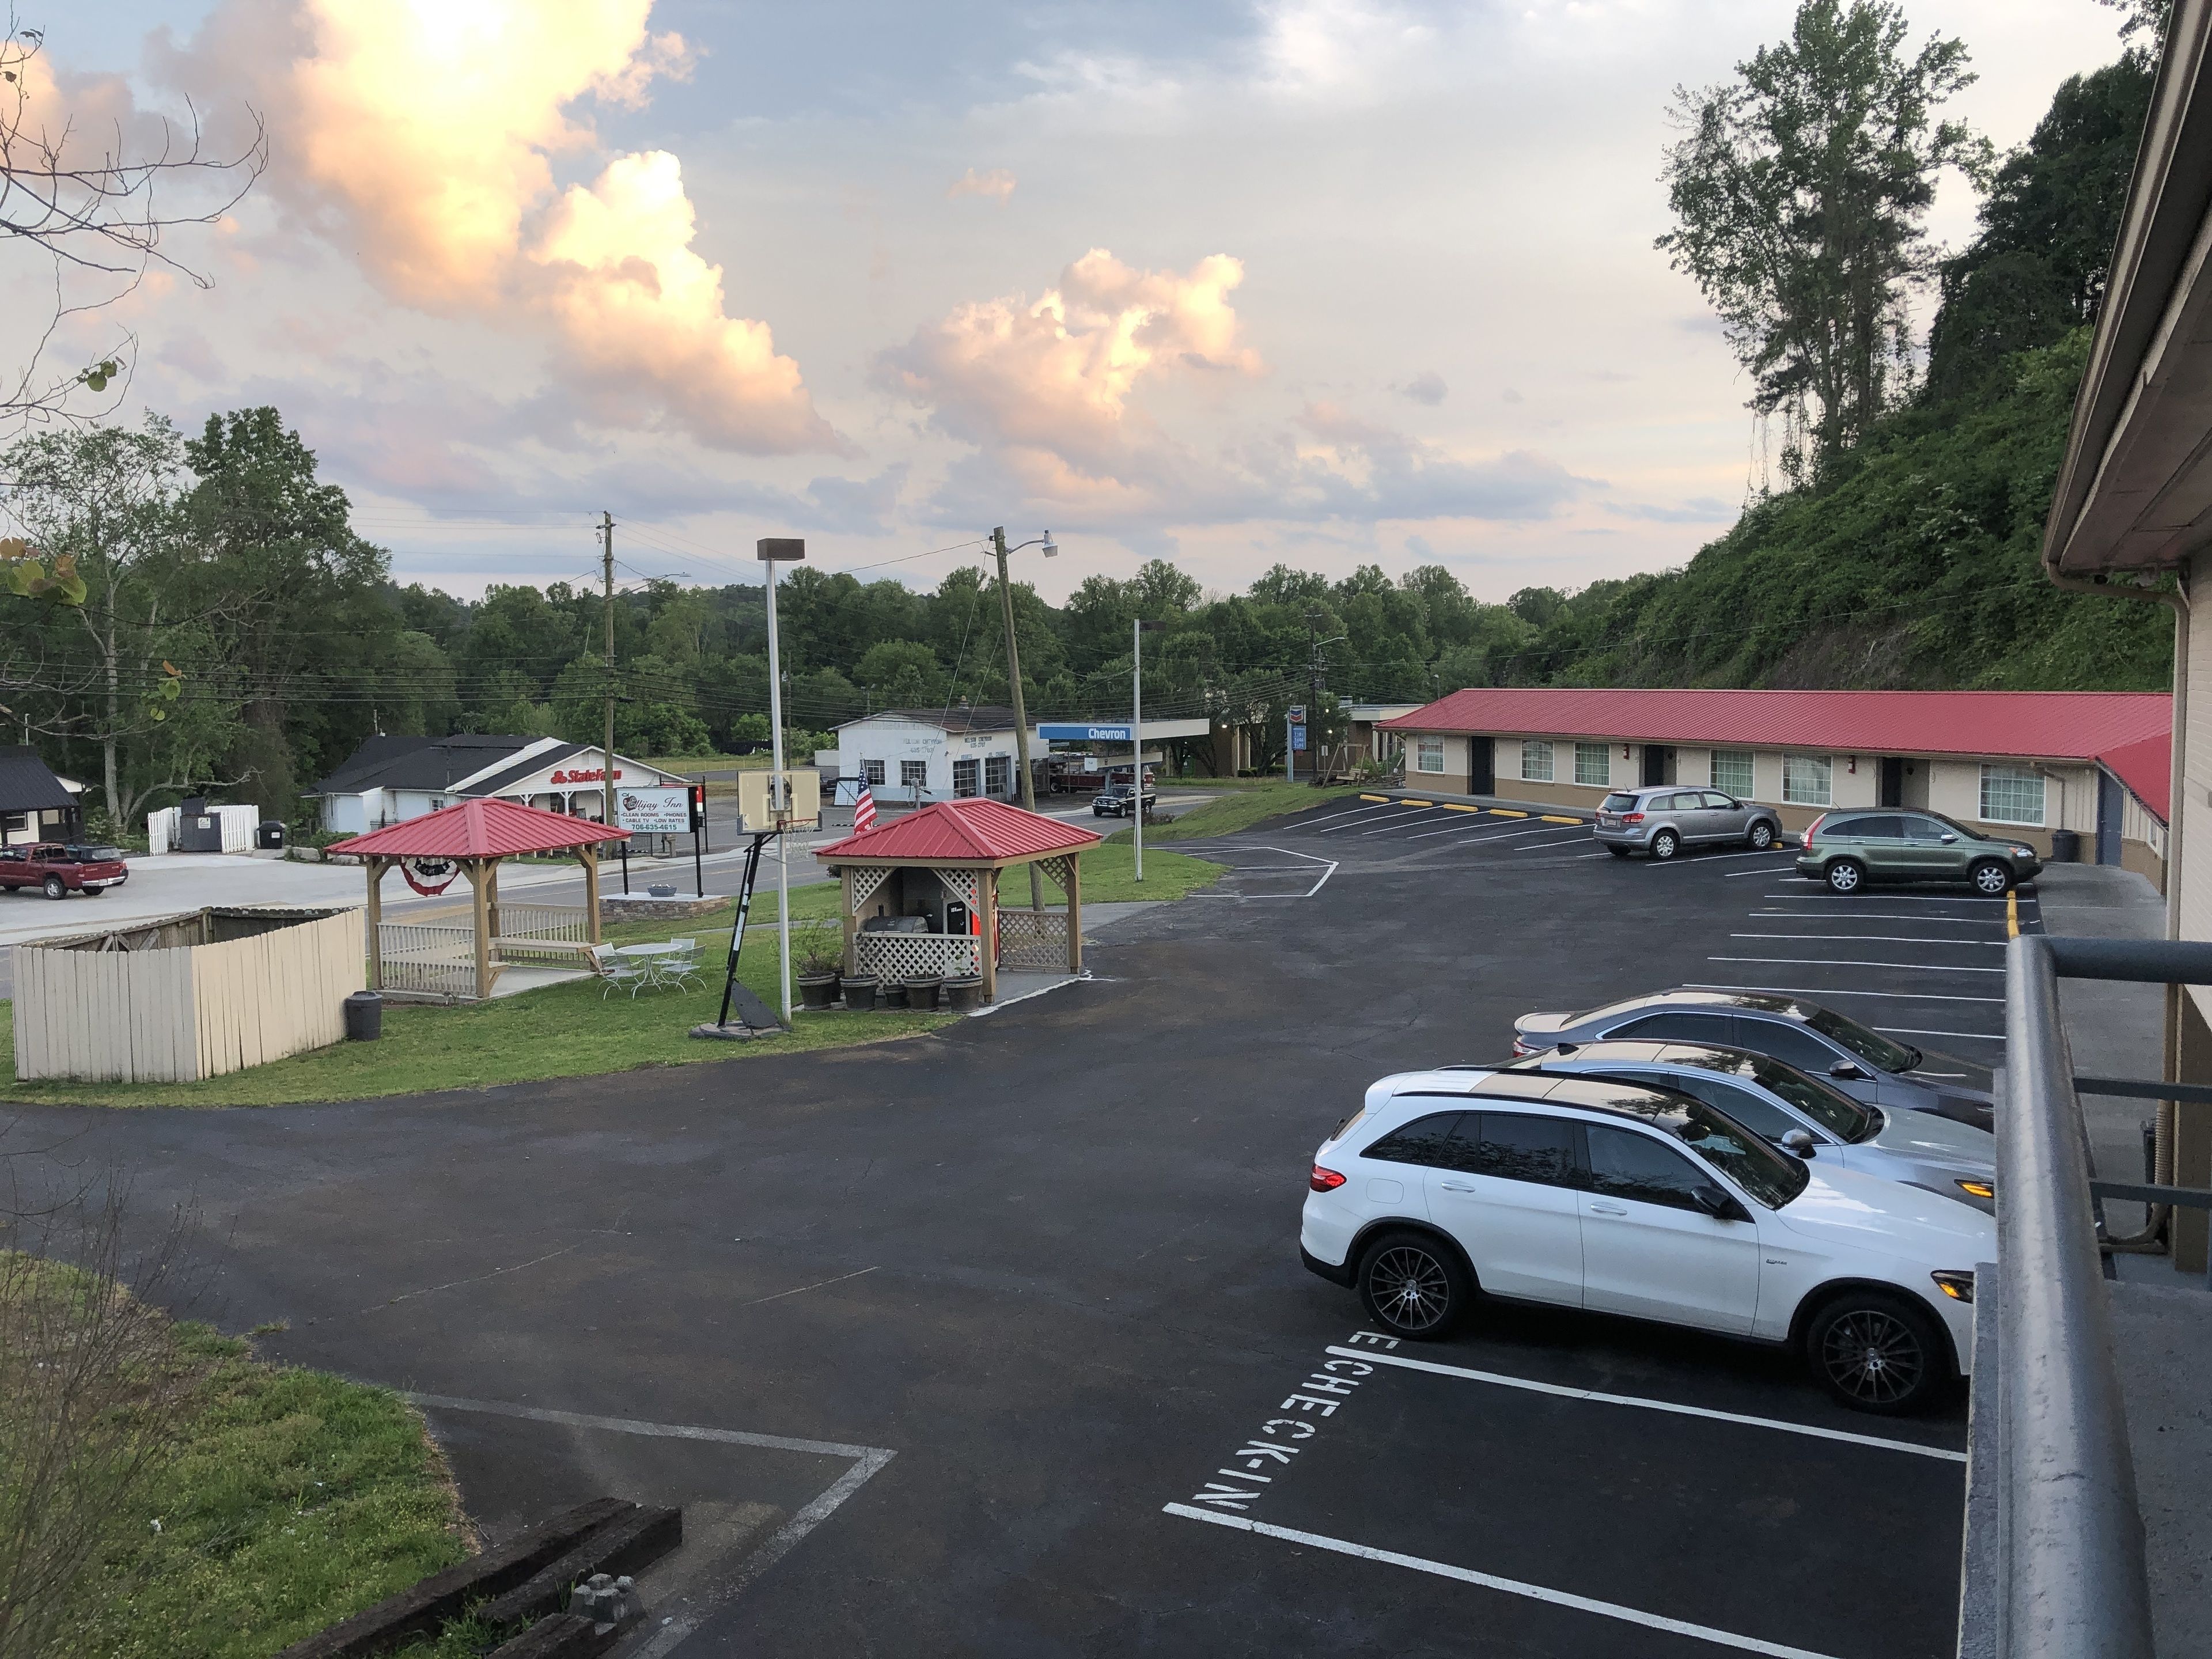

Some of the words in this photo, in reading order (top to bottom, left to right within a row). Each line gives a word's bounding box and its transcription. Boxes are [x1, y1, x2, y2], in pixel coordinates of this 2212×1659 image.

[1088, 728, 1126, 740] Chevron
[596, 768, 622, 781] Fam
[626, 795, 659, 811] Ellijay
[663, 797, 684, 808] Inn
[1192, 1360, 1373, 1510] CHECK-IN
